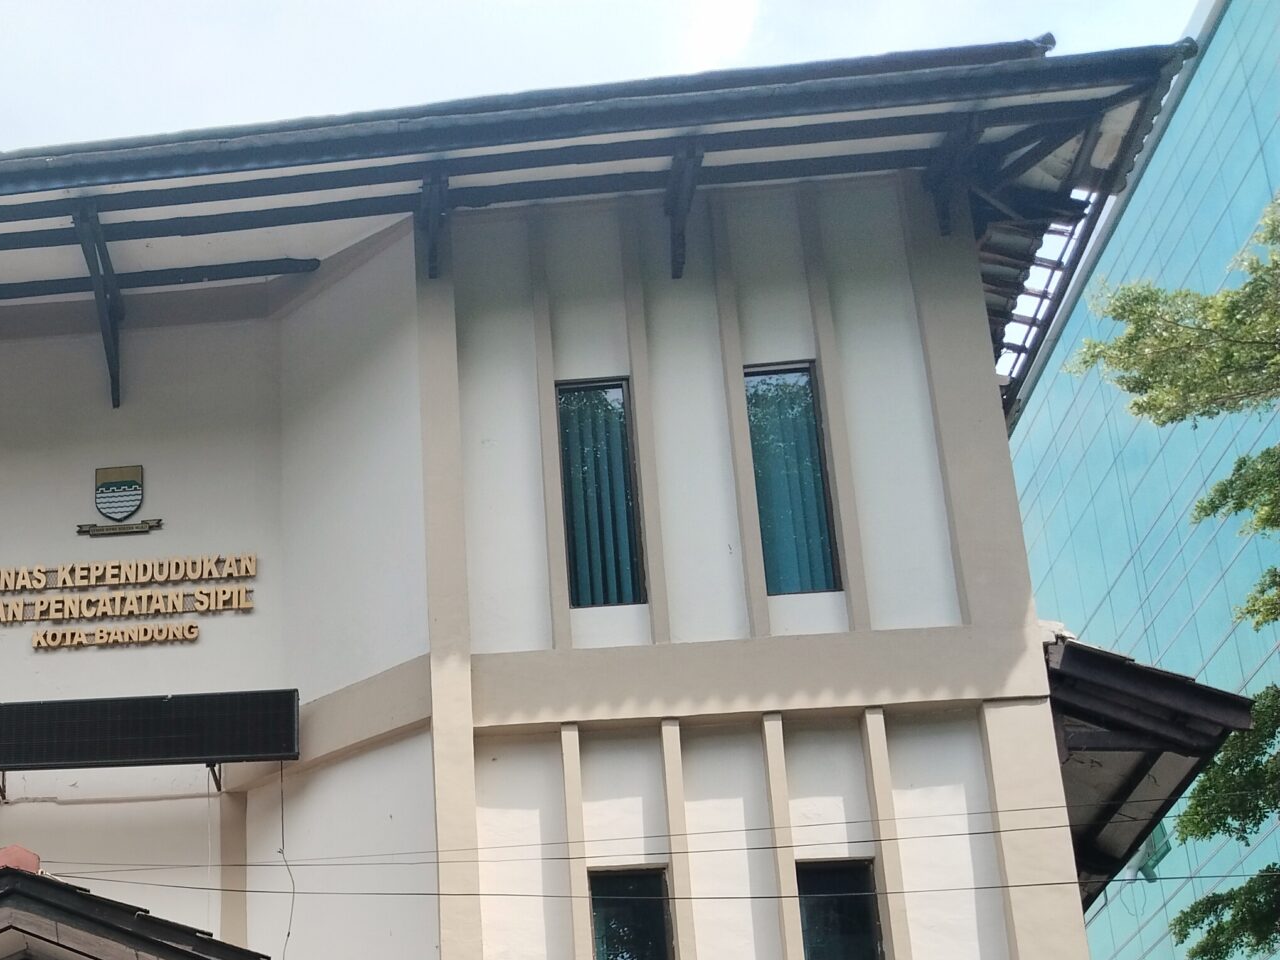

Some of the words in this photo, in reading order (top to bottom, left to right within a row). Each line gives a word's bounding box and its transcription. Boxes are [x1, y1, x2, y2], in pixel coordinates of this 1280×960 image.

[57, 554, 257, 587] KEPENDUDUKAN
[34, 588, 184, 620] PENCATATAN
[194, 586, 254, 611] SIPIL
[31, 629, 87, 649] KOTA
[94, 621, 199, 645] BANDUNG
